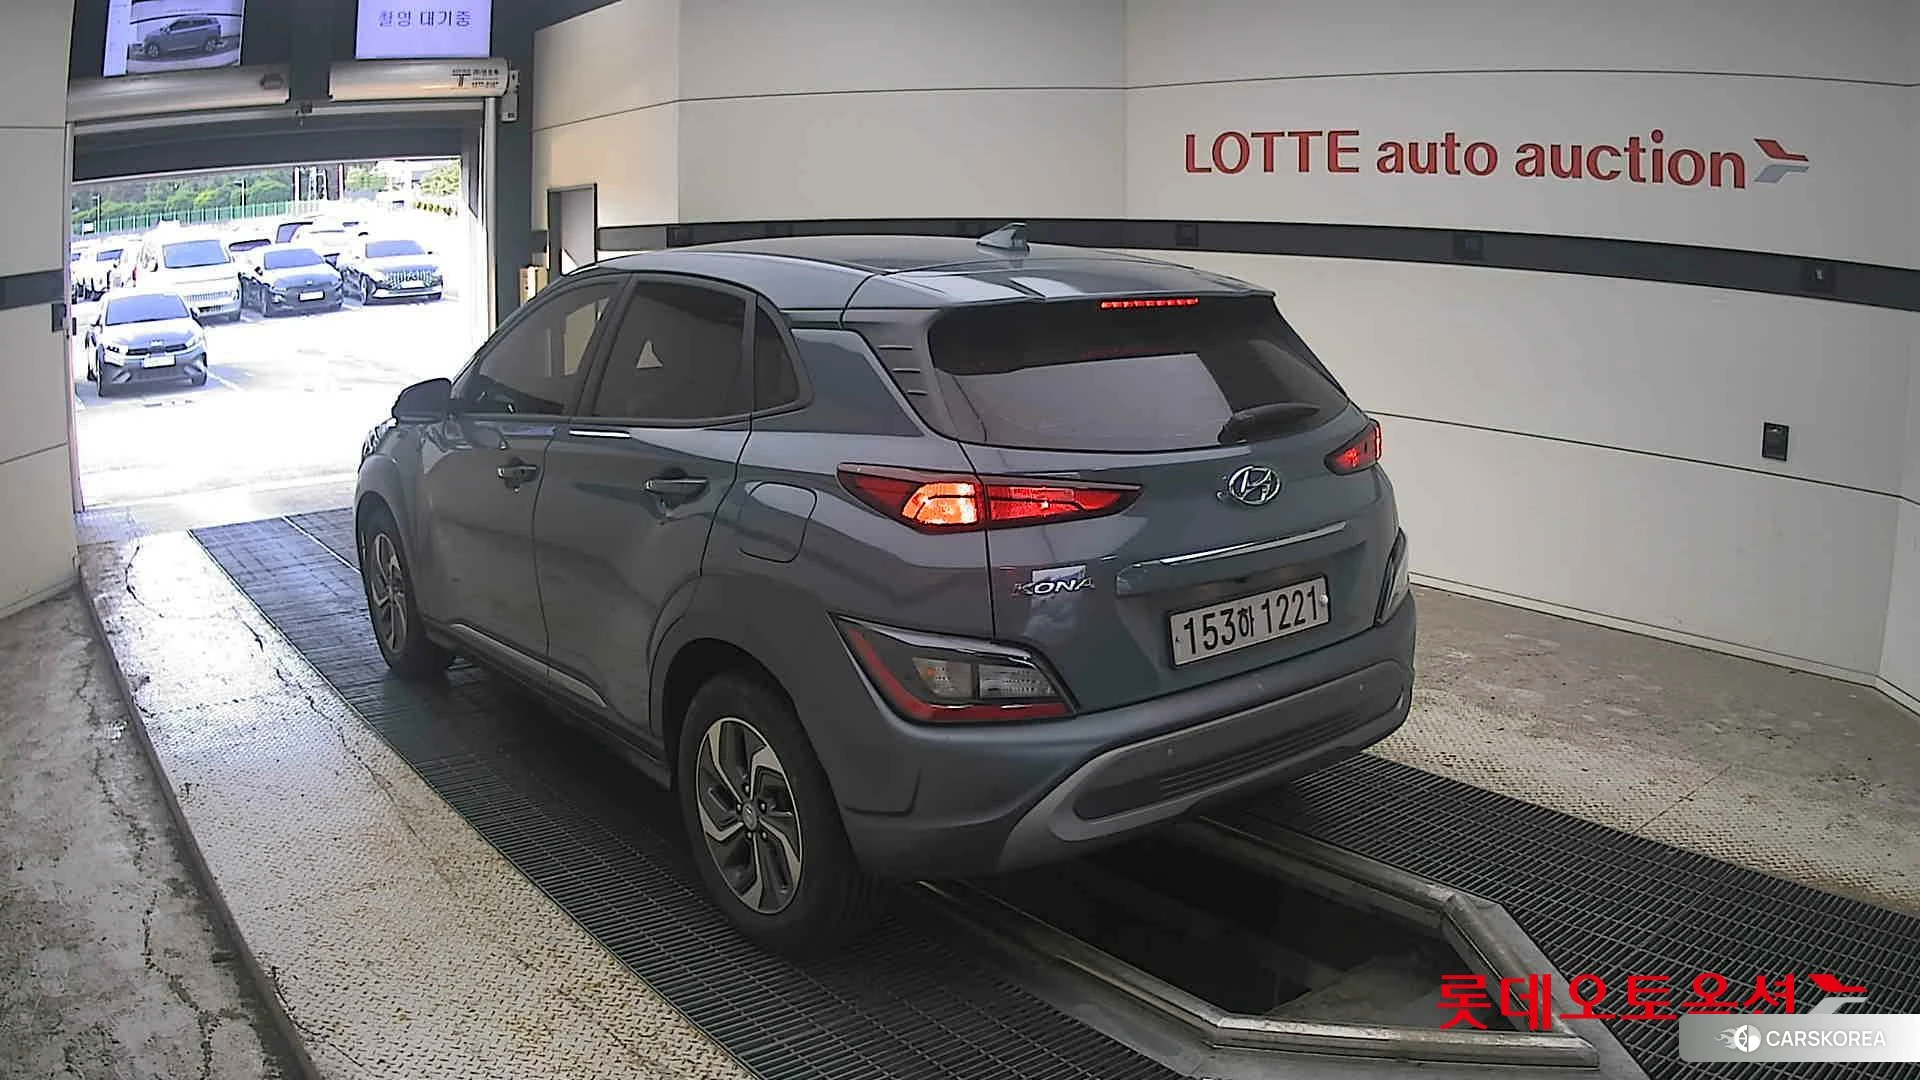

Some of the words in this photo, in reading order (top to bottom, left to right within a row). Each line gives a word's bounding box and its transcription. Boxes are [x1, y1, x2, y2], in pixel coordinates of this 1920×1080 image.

[420, 10, 471, 27] 대기중
[1185, 130, 1360, 174] LOTTE
[1376, 132, 1498, 176] auto
[1515, 129, 1746, 189] auction
[1011, 577, 1096, 598] KONA
[1261, 585, 1317, 634] 1221
